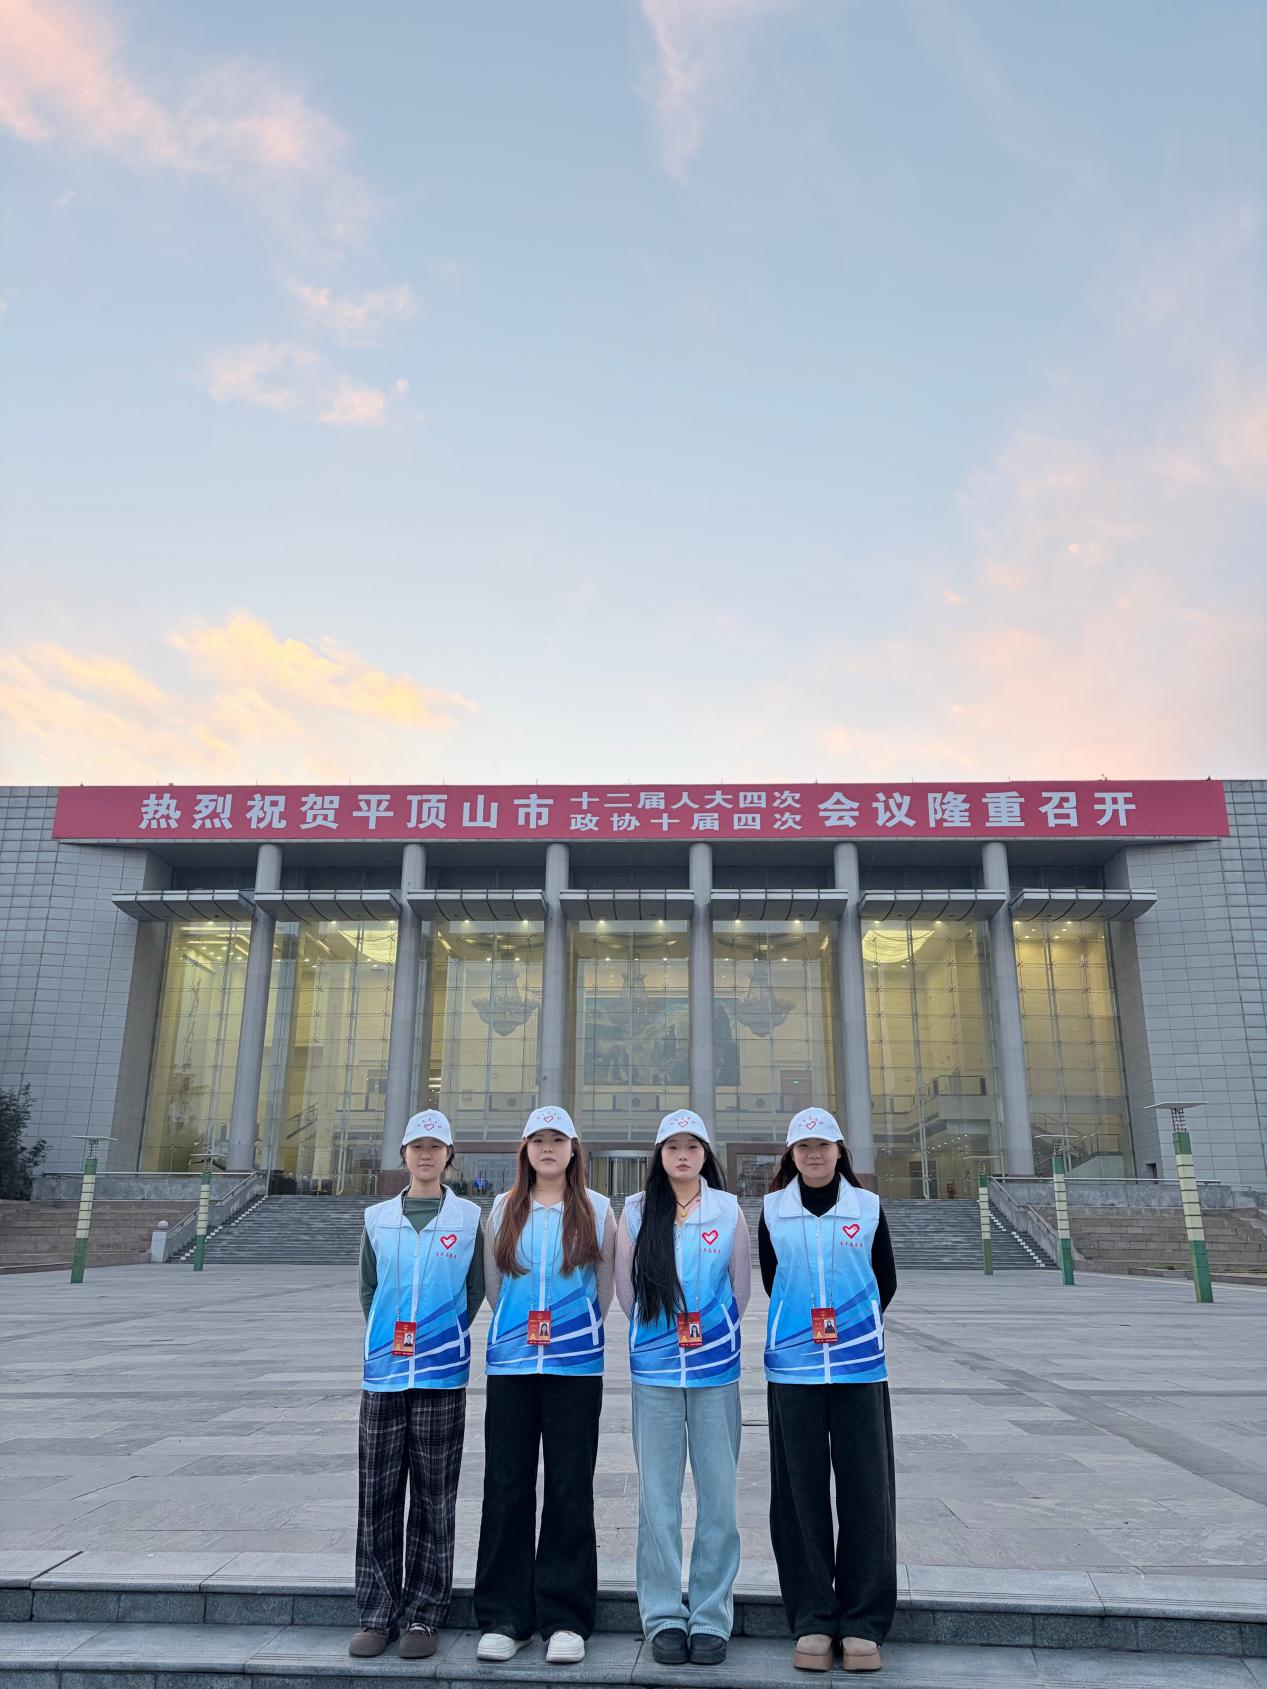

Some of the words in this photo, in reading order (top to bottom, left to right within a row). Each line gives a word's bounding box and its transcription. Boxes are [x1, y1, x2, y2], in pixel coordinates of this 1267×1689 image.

[138, 793, 554, 830] 热烈祝贺平顶山市
[570, 790, 802, 810] 十二届人大四次
[817, 791, 1137, 828] 会议隆重召开
[569, 811, 802, 832] 政协十届四次
